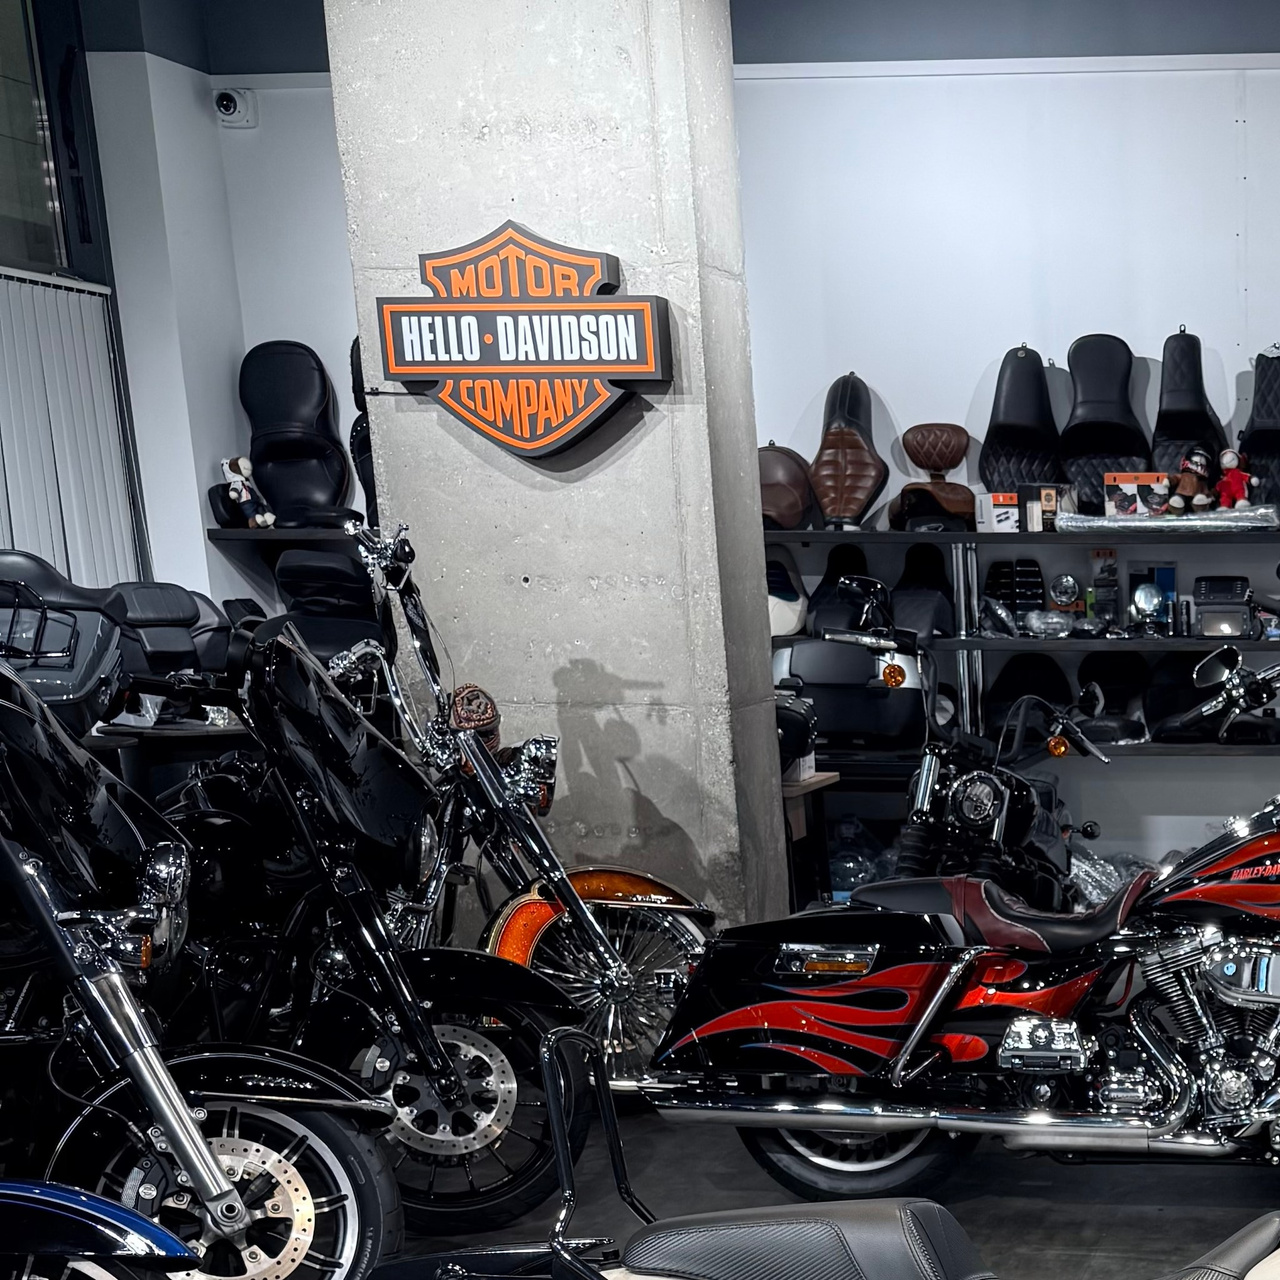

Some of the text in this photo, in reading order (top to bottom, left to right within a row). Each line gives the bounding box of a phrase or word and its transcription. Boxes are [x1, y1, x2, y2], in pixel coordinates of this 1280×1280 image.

[450, 244, 579, 298] MOTOR
[401, 314, 638, 361] HELLO DAVIDSON
[459, 378, 588, 438] COMPANY
